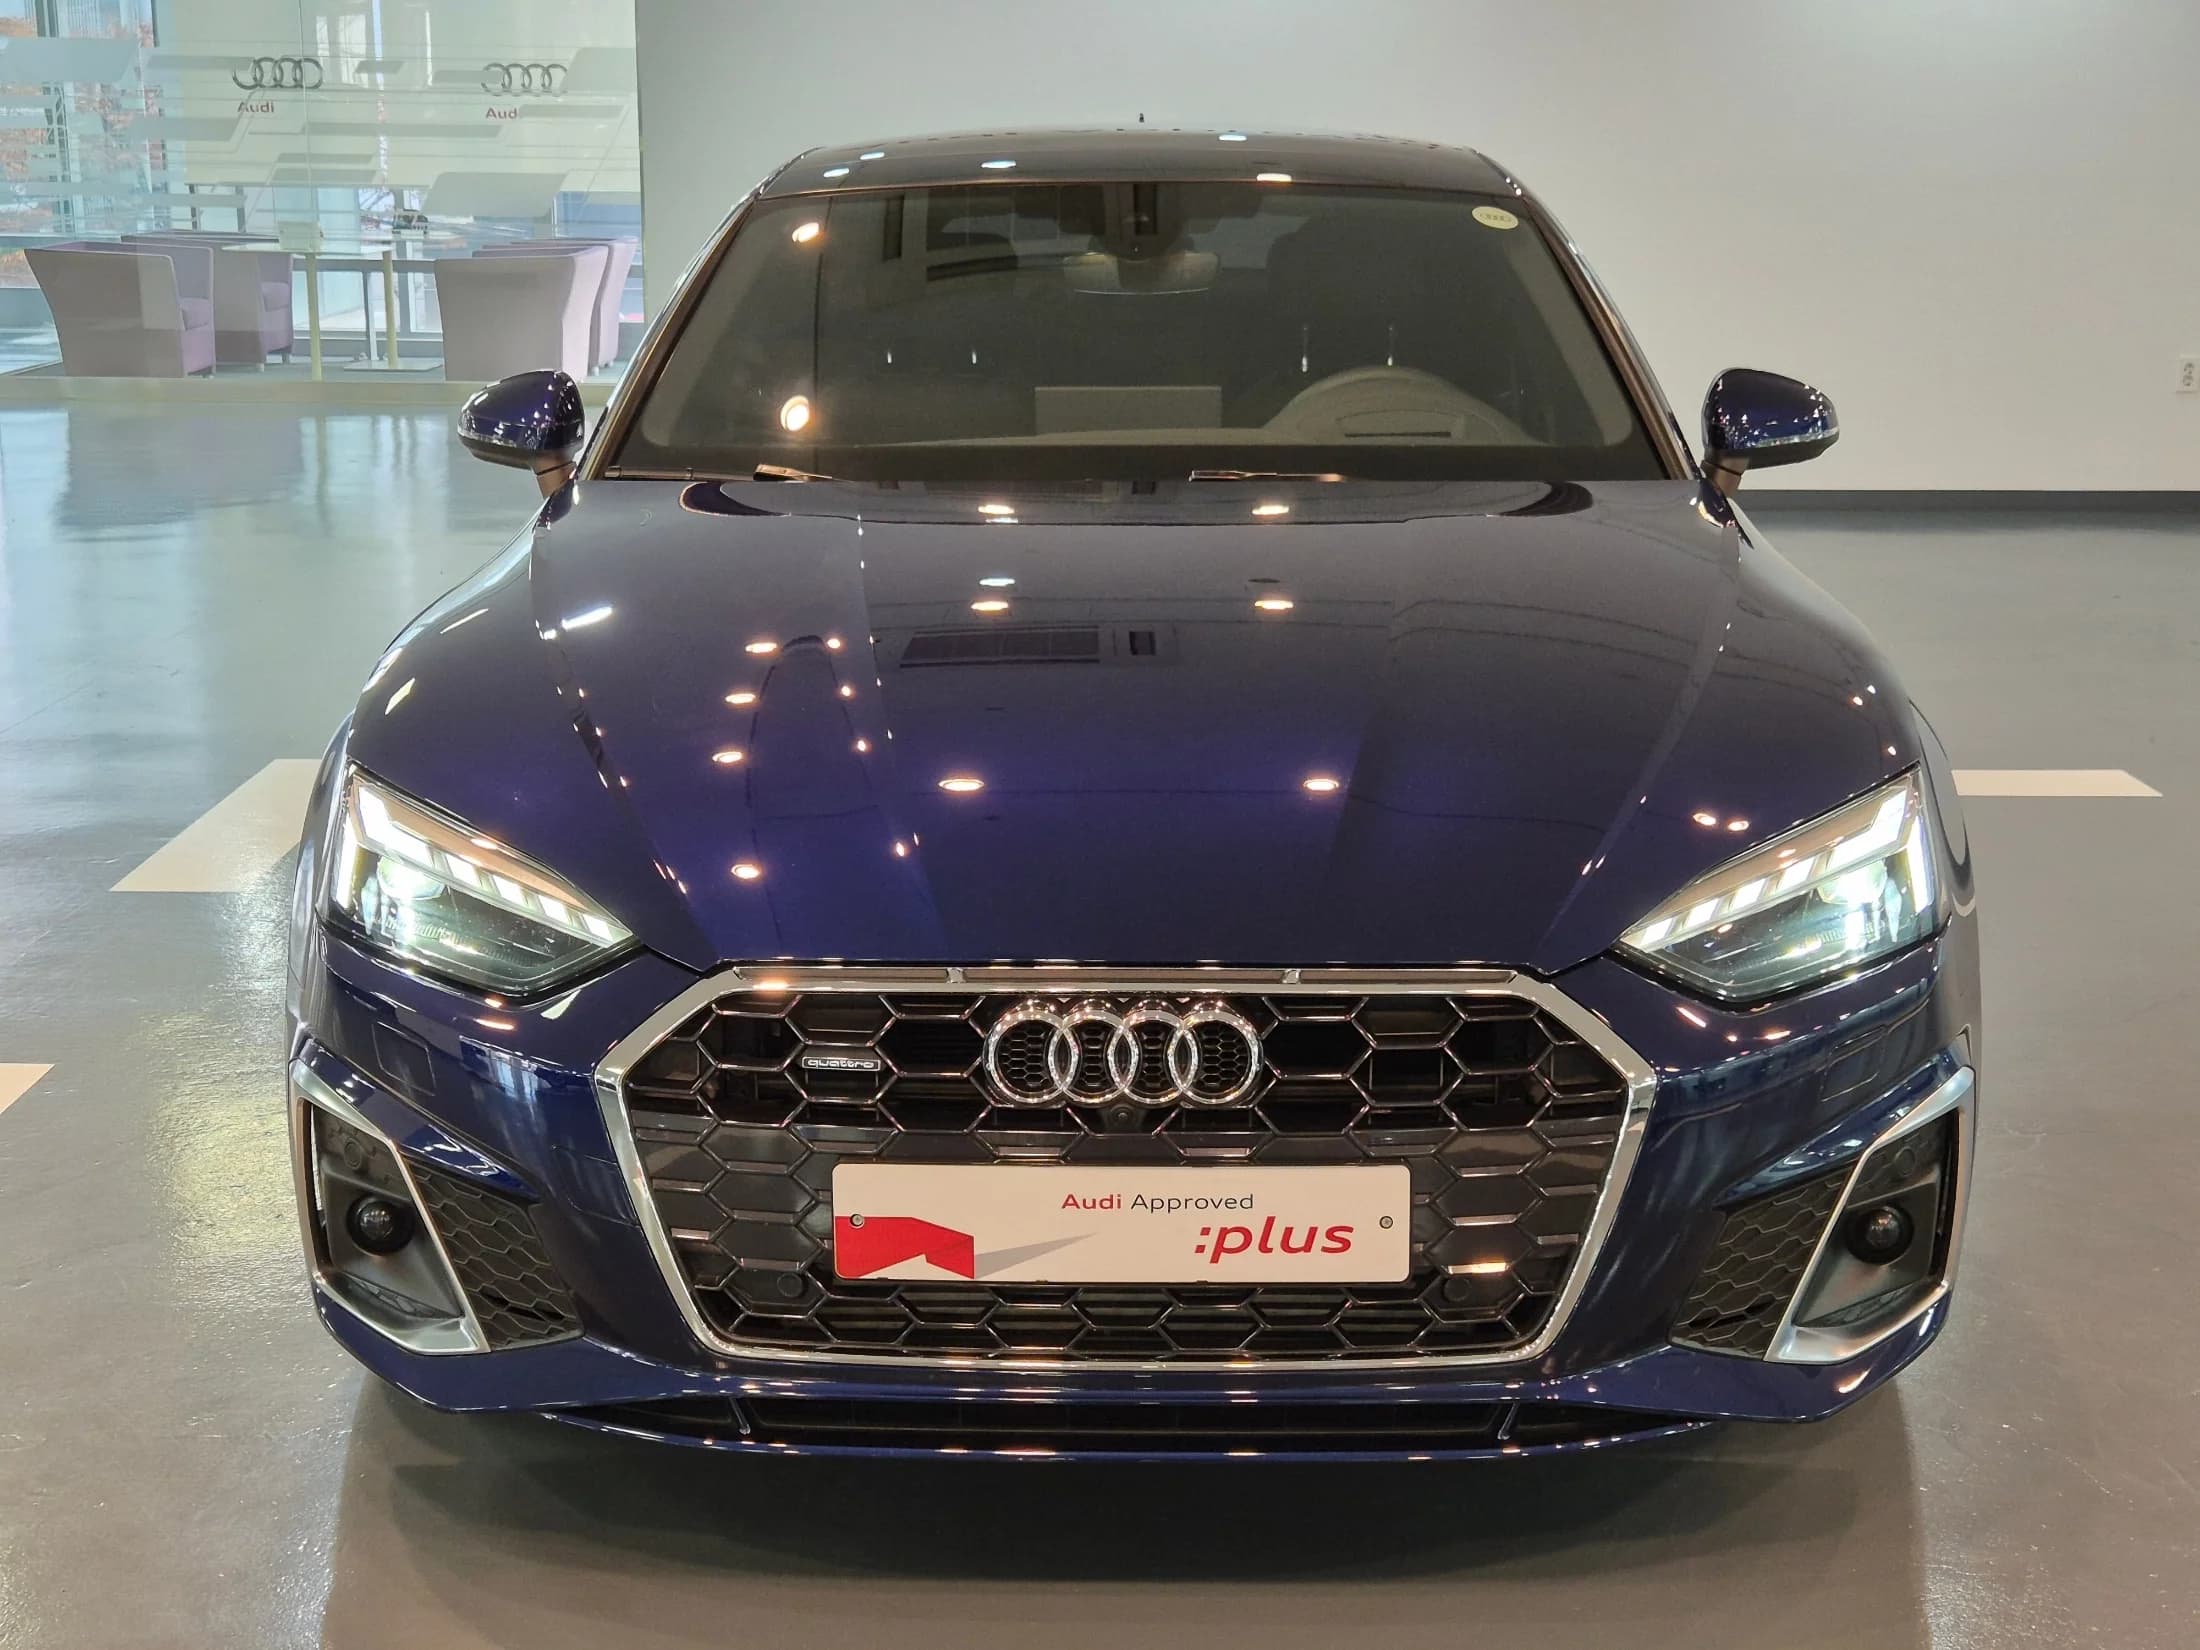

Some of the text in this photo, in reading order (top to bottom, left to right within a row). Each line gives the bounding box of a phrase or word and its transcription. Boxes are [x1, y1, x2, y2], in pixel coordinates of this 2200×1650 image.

[237, 101, 274, 112] Audi
[486, 107, 520, 119] Aud
[807, 1059, 875, 1069] quattro
[1061, 1193, 1254, 1213] Audi Approved
[1195, 1215, 1354, 1264] :plus
